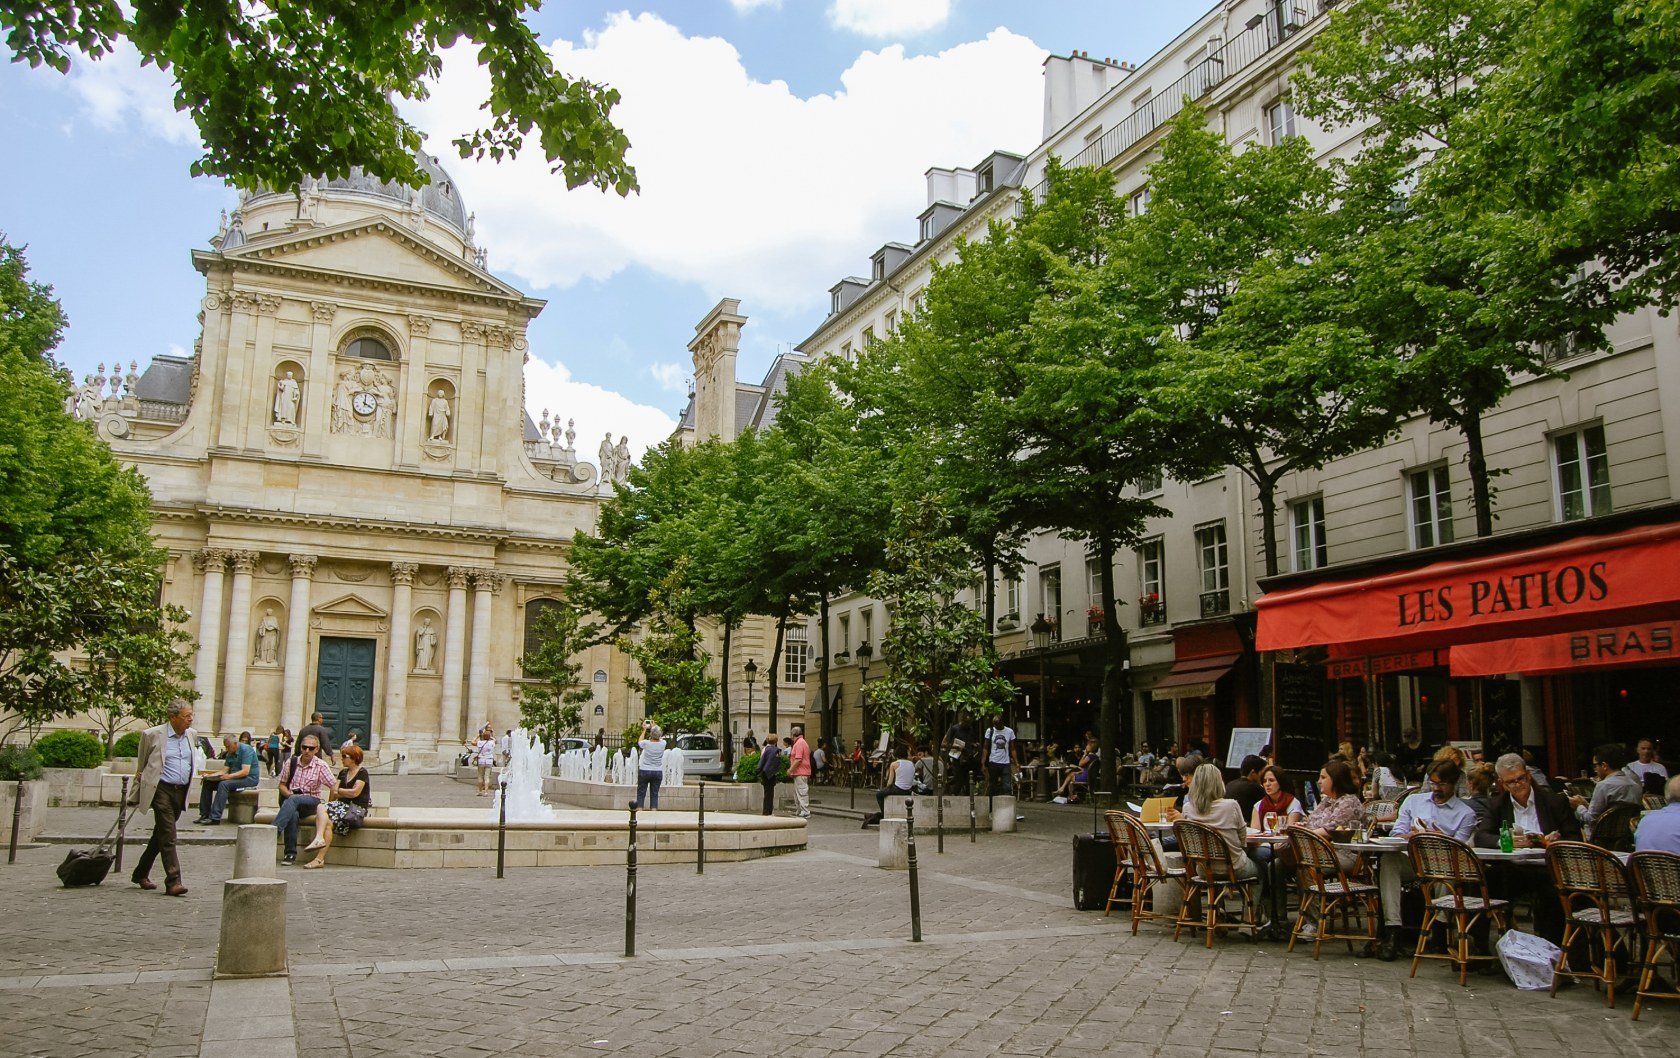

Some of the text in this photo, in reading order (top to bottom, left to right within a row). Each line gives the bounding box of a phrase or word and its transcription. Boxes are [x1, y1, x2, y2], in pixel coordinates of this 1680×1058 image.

[1397, 561, 1609, 627] LES PATIOS
[1570, 627, 1673, 660] BRAS
